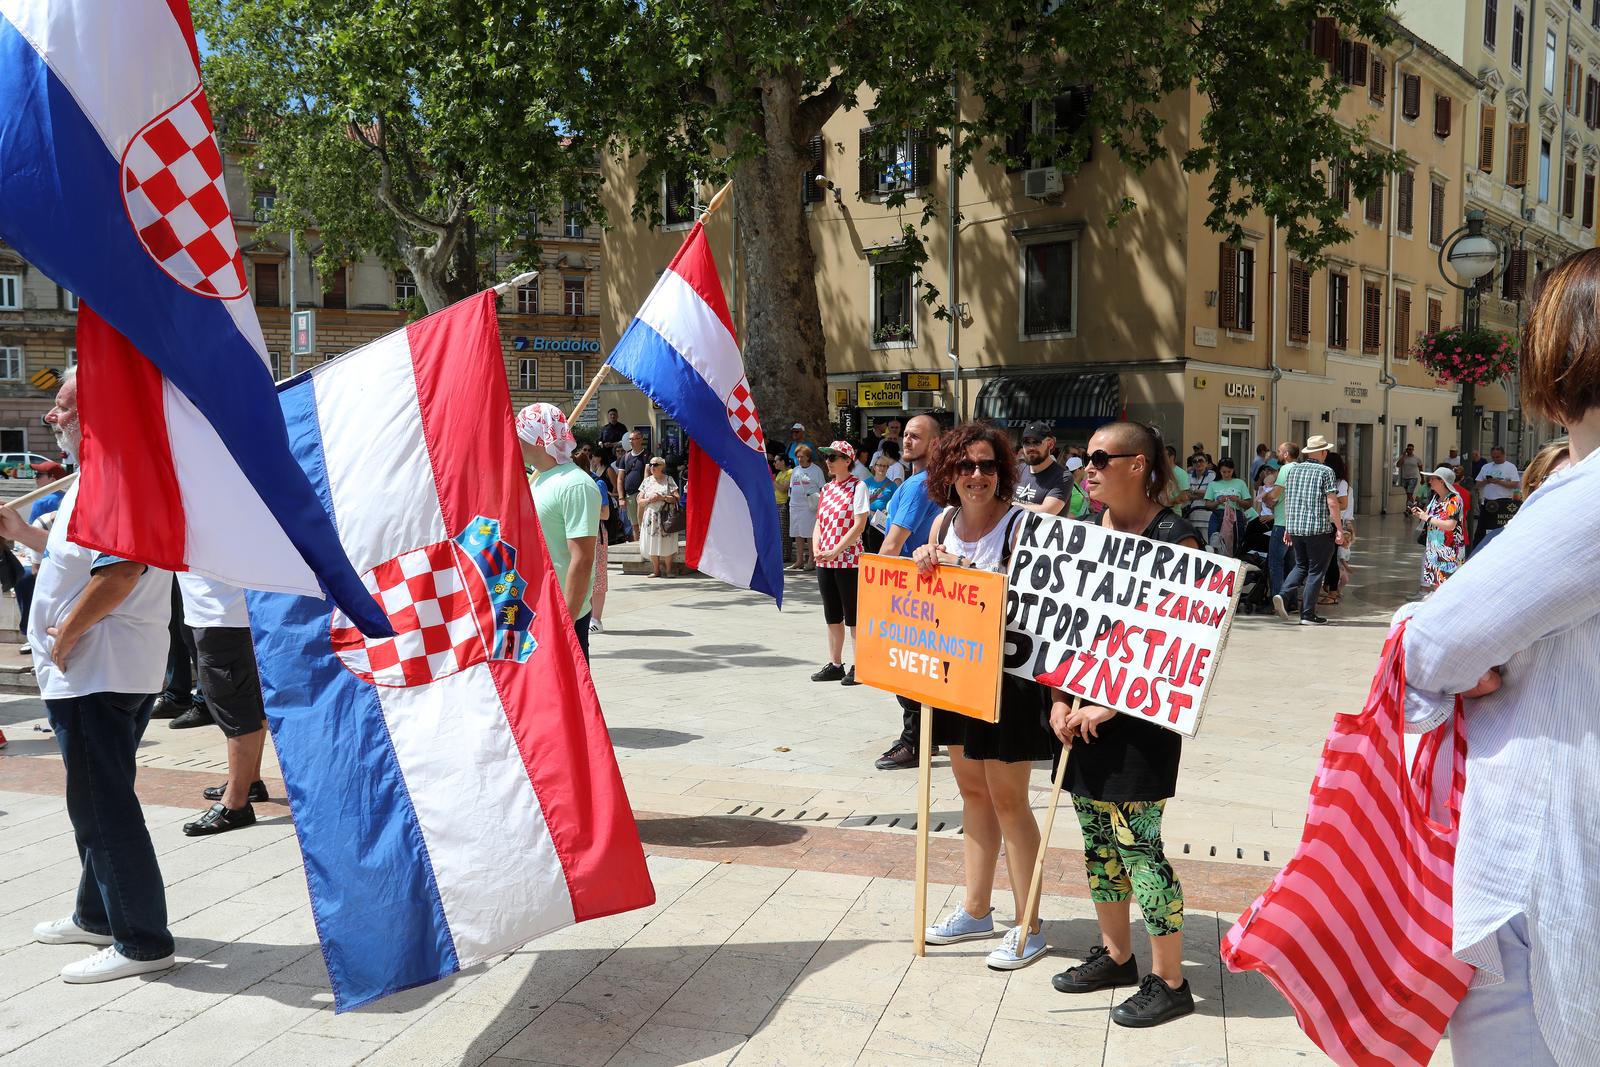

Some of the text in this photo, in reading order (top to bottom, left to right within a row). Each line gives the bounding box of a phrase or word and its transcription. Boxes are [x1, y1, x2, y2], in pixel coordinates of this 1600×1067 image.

[884, 382, 901, 390] Mon
[864, 565, 986, 614] U IME MAJKE,
[1010, 550, 1226, 630] POSTAJE ZAKON
[1019, 512, 1236, 598] KAD NEPRAVDA
[869, 618, 985, 664] I SOLIDARNOSTI
[1003, 630, 1193, 725] DUŽNOST
[1005, 589, 1211, 688] OTPOR POSTAJE
